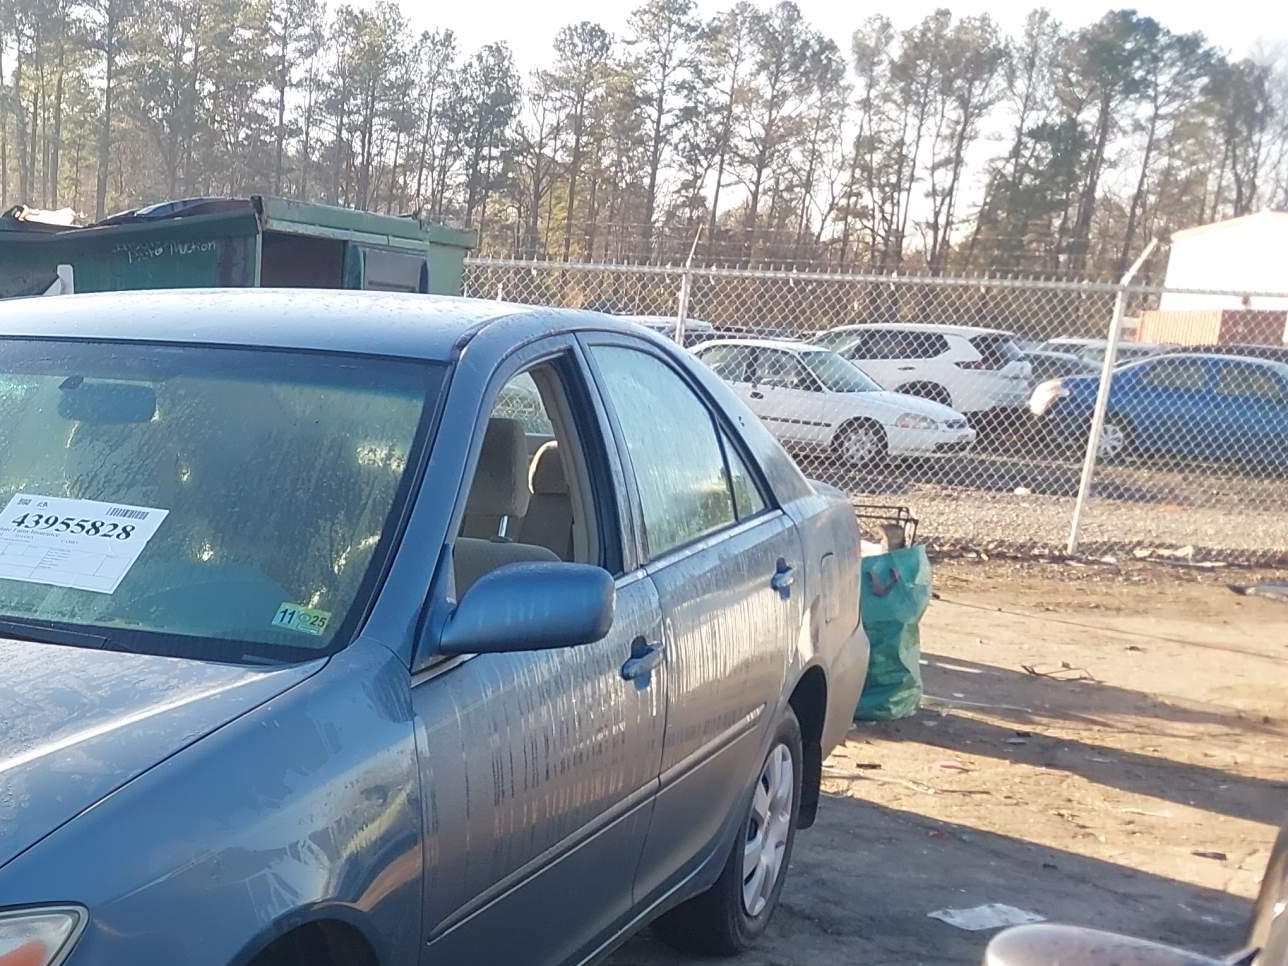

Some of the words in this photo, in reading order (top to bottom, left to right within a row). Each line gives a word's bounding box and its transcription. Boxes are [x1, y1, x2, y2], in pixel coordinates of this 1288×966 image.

[11, 512, 135, 540] 43955828
[279, 608, 296, 624] 11
[310, 615, 327, 628] 25
